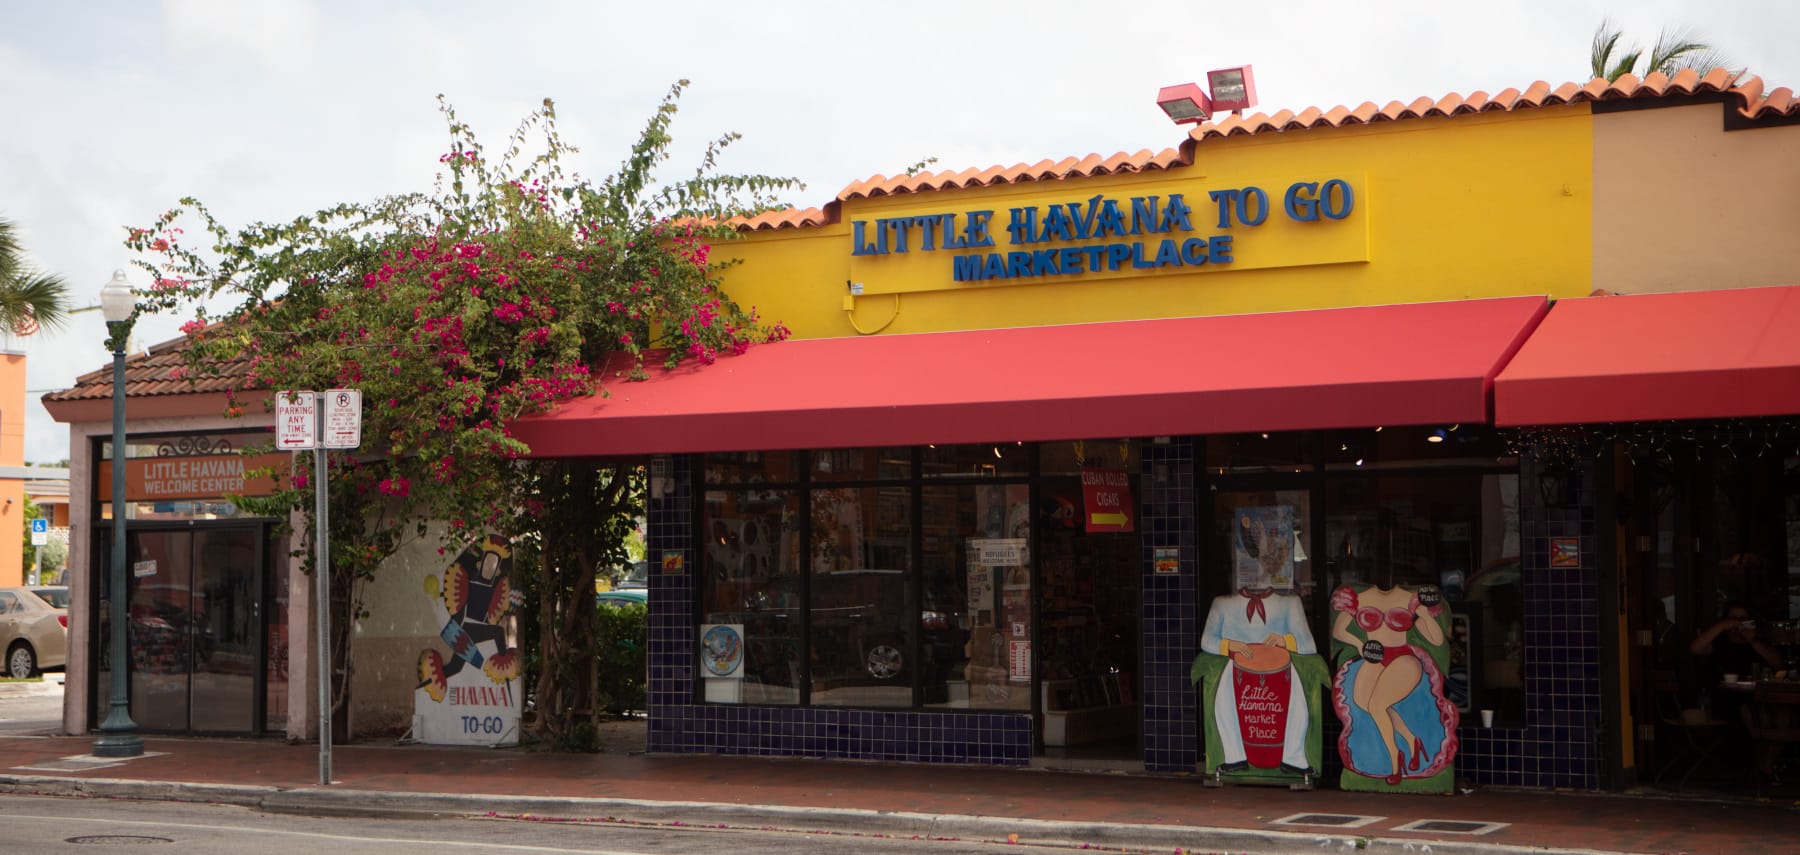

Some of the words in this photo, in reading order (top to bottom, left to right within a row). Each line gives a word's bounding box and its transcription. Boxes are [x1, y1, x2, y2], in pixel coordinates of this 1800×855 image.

[851, 209, 996, 257] LITTLE
[1007, 194, 1193, 245] HAVANA
[1208, 186, 1269, 229] TO
[1284, 179, 1353, 222] GO
[952, 235, 1234, 283] MARKETPLACE
[279, 406, 313, 415] PARKING
[288, 415, 305, 424] ANY
[287, 425, 306, 433] TIME
[144, 462, 189, 480] LITTLE
[190, 460, 244, 478] HAVANA
[144, 479, 200, 494] WELCOME
[201, 478, 244, 492] CENTER
[1082, 471, 1105, 486] CUBAN
[1105, 472, 1129, 487] ROLLED
[1096, 491, 1120, 507] CIGARS
[456, 687, 508, 707] HAVANA
[1241, 684, 1280, 701] Little
[1239, 699, 1284, 713] Havana
[461, 715, 503, 734] TO-GO
[1248, 725, 1278, 739] Place
